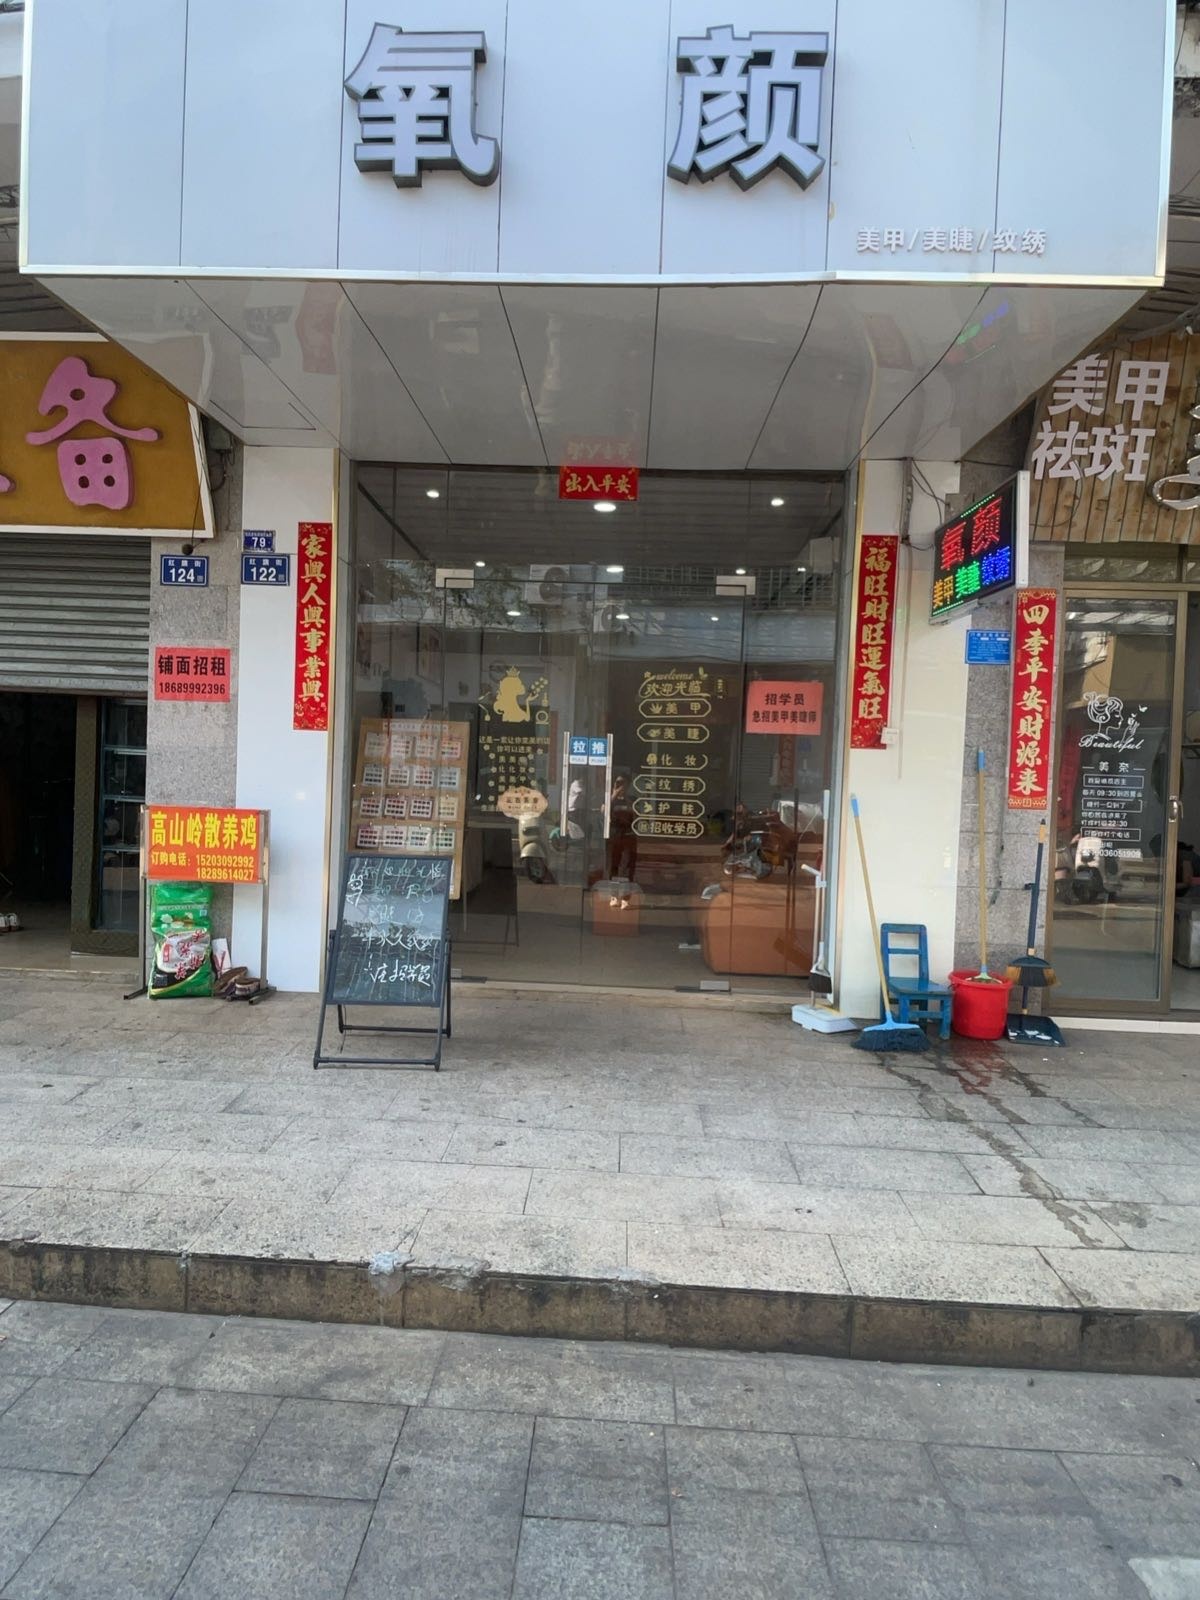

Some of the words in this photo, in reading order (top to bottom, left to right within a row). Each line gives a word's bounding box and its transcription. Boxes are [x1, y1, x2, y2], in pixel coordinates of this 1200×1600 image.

[344, 22, 829, 188] 氧颜
[1047, 353, 1170, 421] 美甲
[1031, 420, 1156, 482] 祛斑
[565, 473, 632, 494] 出入平安
[252, 537, 266, 547] 79
[169, 567, 195, 582] 124
[250, 567, 277, 581] 122
[158, 655, 226, 676] 铺面招租
[159, 682, 226, 695] 18689992396
[764, 693, 805, 705] 招学员
[665, 702, 701, 714] 美甲
[573, 740, 586, 753] 拉
[592, 741, 605, 754] 推
[661, 753, 697, 766] 化妆
[658, 779, 695, 792] 纹绣
[658, 802, 694, 815] 护肤
[151, 810, 257, 850] 高山岭散养鸡
[650, 821, 697, 835] 招收学员
